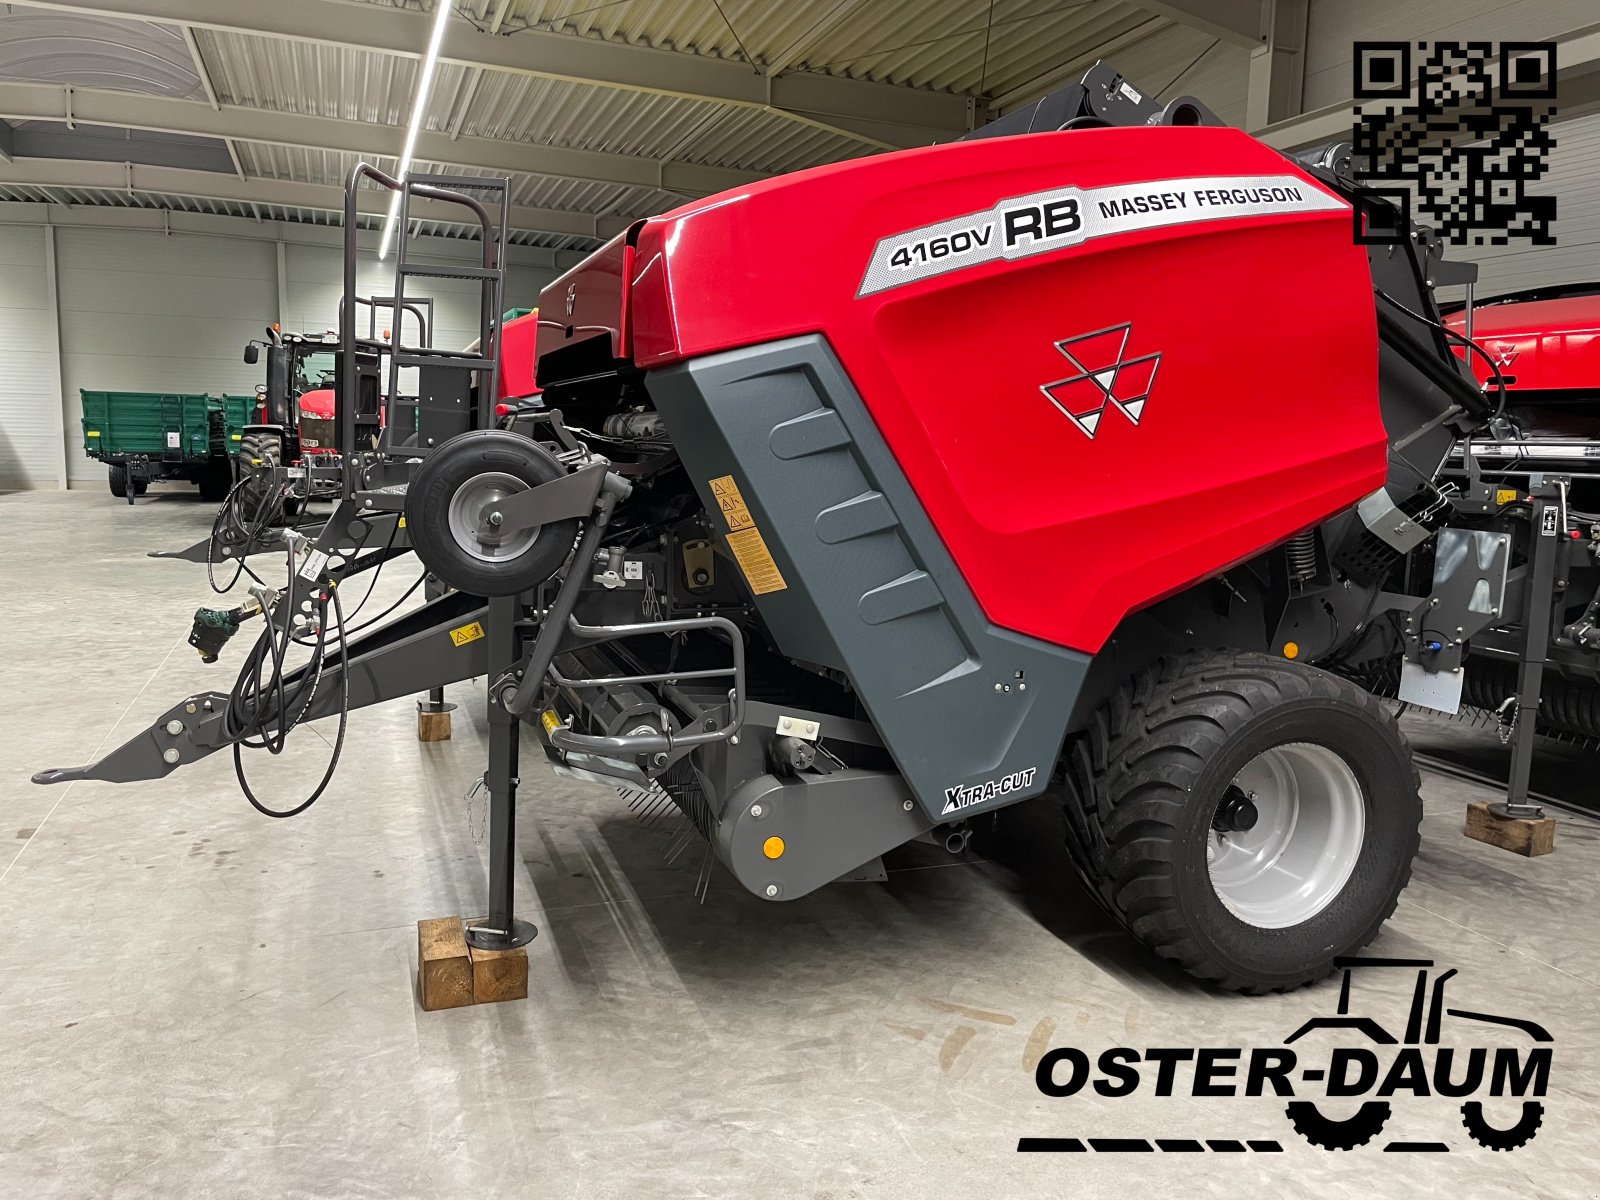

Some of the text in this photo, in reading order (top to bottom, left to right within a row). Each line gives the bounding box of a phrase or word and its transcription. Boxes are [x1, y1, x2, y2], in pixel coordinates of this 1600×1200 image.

[890, 187, 1302, 267] 4160V RB MASSEY FERGUSON
[942, 767, 1036, 815] XTRA-CUT
